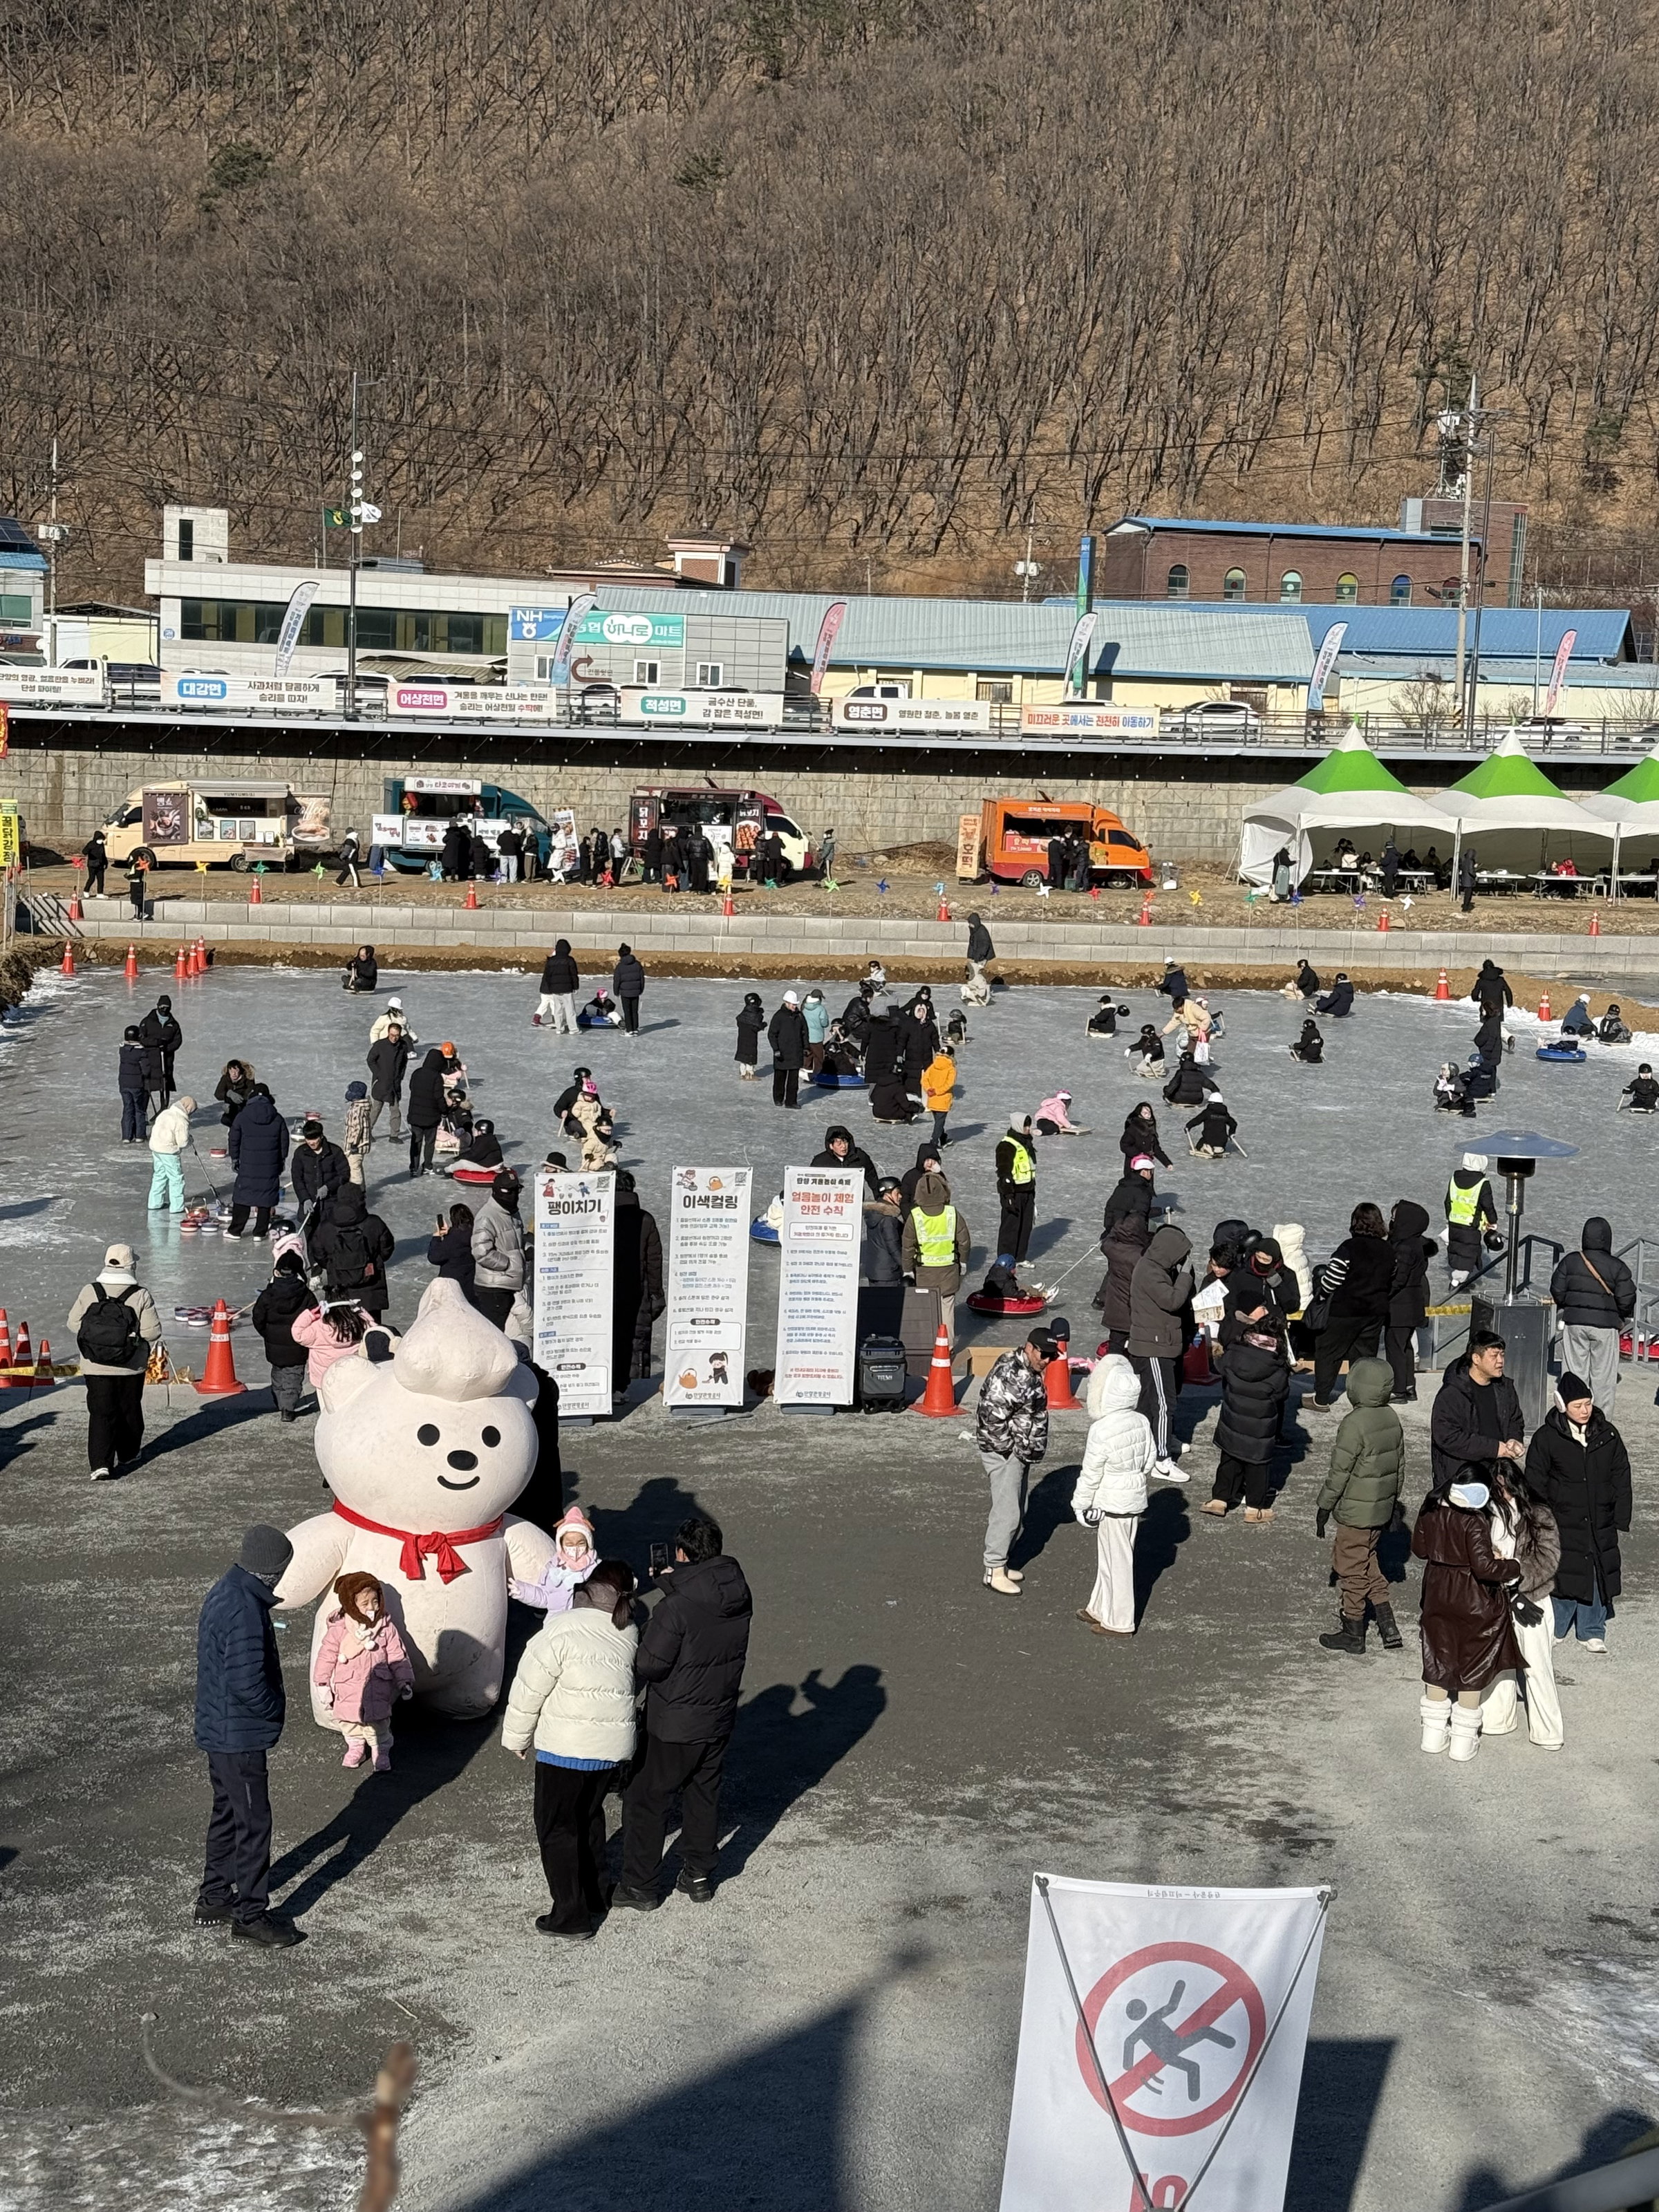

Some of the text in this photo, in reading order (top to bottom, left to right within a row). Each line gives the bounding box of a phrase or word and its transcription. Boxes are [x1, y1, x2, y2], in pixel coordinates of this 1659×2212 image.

[516, 610, 543, 622] NH
[607, 619, 648, 637] 하나로
[655, 625, 682, 637] 마트
[182, 682, 222, 696] 대강면
[247, 681, 320, 693] 사과처럼 달콤하게
[259, 693, 308, 704] 승리를 따자!
[400, 693, 444, 706] 어상천면
[453, 691, 478, 700] 겨울을
[480, 691, 503, 700] 깨우는
[505, 692, 528, 701] 신나는
[708, 697, 735, 707] 금수산
[460, 703, 483, 711] 승리는
[646, 700, 682, 713] 적성면
[848, 705, 883, 719] 영춘면
[714, 709, 731, 718] 잡은
[734, 710, 763, 720] 적성면!
[1028, 713, 1154, 729] 미끄러운 곳에서는 천천히 이동하기
[294, 801, 329, 821] coffee
[683, 1195, 738, 1209] 이색컬링
[791, 1192, 854, 1203] 얼음놀이 체험
[547, 1199, 601, 1215] 팽이치기
[801, 1205, 843, 1216] 안전 수칙
